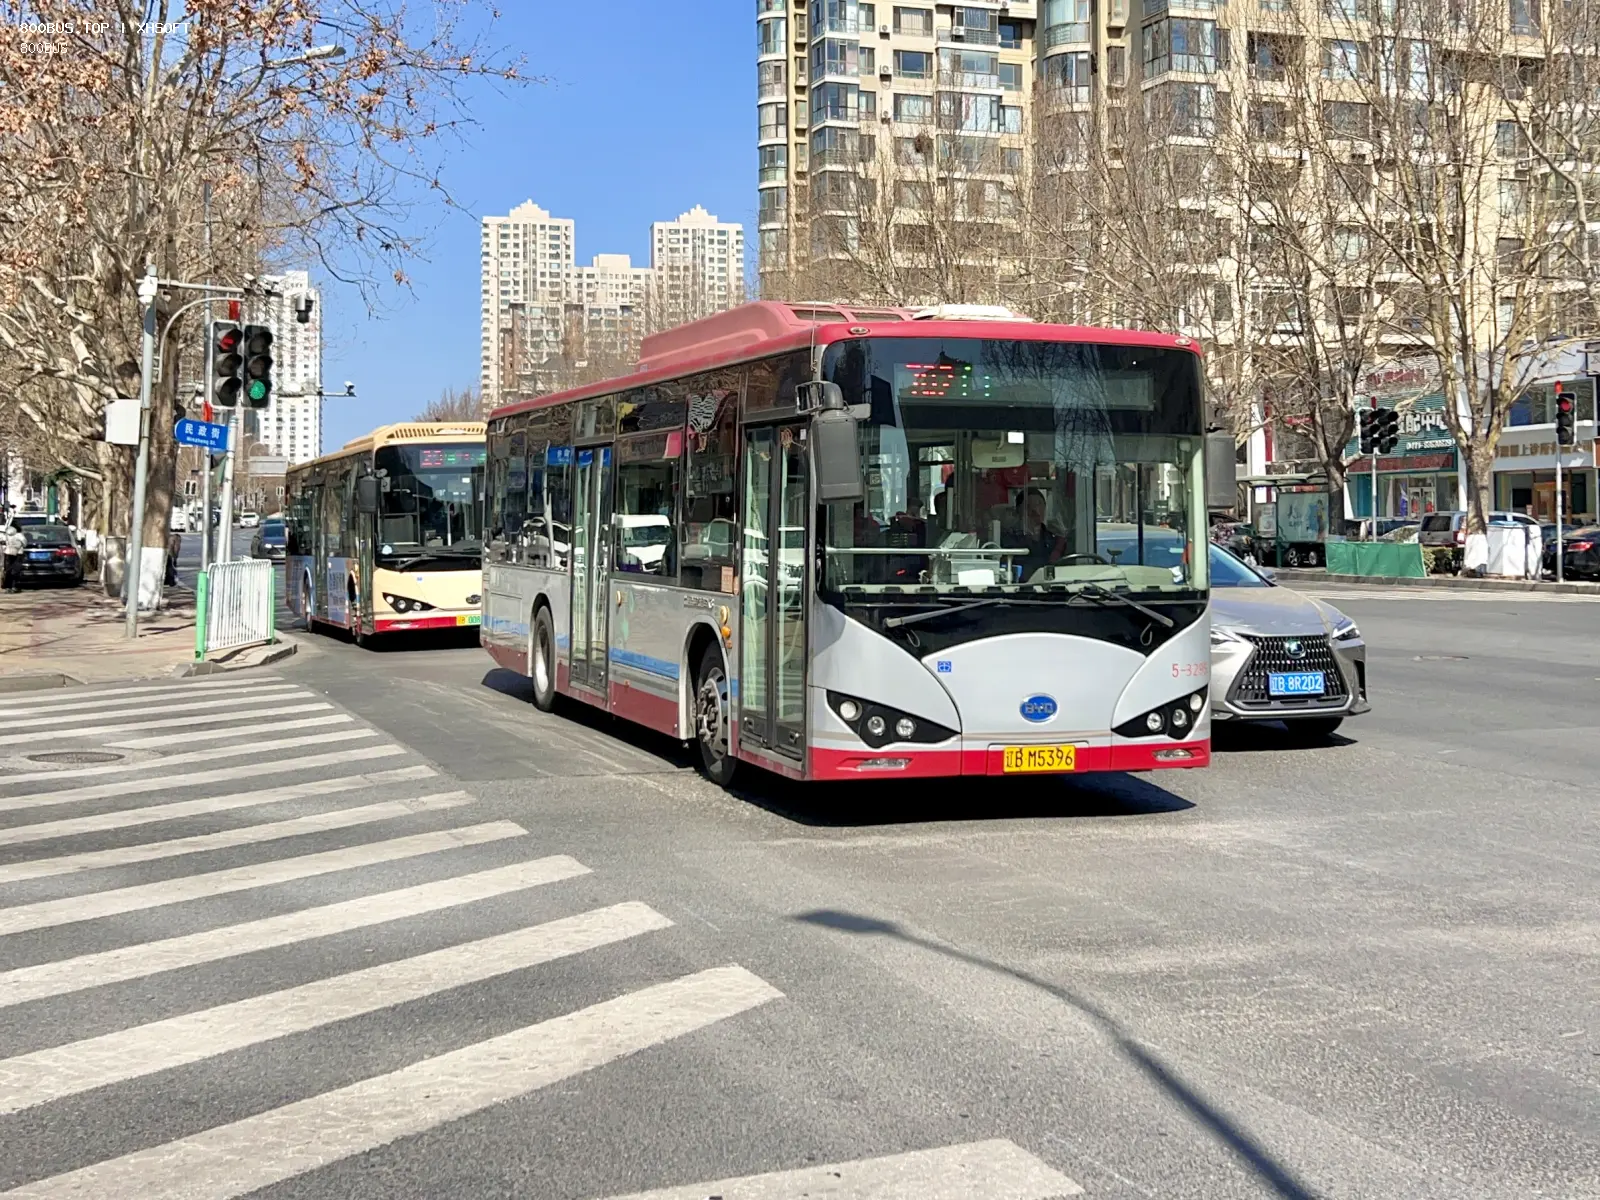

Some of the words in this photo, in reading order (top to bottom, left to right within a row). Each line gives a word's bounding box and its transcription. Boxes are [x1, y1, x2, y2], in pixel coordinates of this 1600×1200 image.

[185, 423, 220, 439] 民政街
[1025, 703, 1054, 714] BYD
